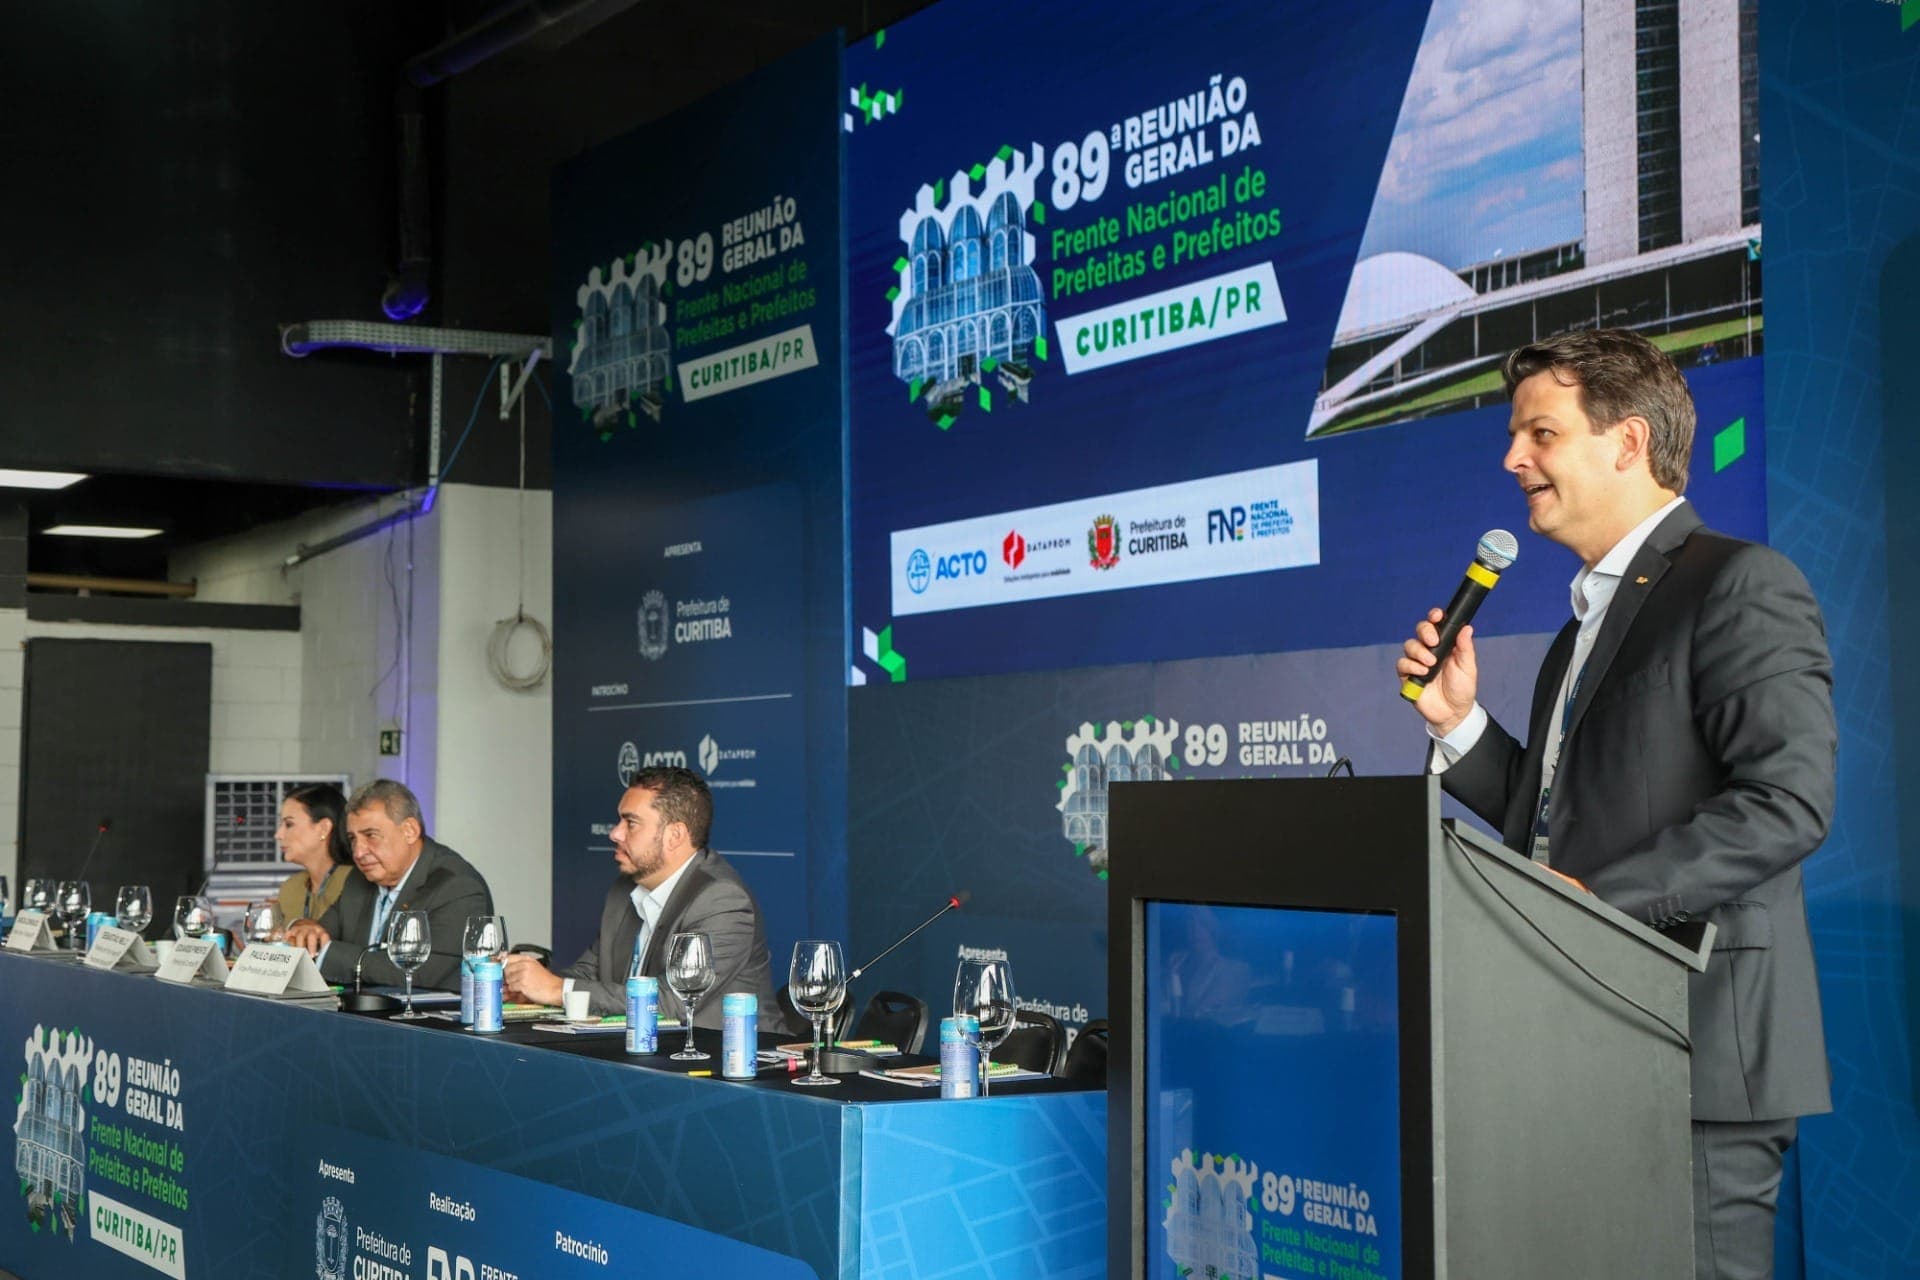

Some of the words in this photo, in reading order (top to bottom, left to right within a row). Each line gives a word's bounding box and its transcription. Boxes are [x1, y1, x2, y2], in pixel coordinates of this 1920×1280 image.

[1123, 74, 1248, 152] REUNIÃO
[1125, 131, 1214, 188] GERAL
[1221, 112, 1262, 157] DA
[1052, 216, 1120, 261] Frente
[1127, 174, 1227, 237] Nacional
[1234, 167, 1267, 199] de
[677, 232, 714, 287] 89
[723, 195, 797, 247] REUNIÃO
[722, 234, 777, 273] GERAL
[780, 221, 805, 253] DA
[1053, 249, 1146, 299] Prefeitas
[1152, 244, 1166, 270] e
[1173, 208, 1281, 265] Prefeitos
[677, 291, 719, 320] Frente
[723, 263, 785, 306] Nacional
[788, 261, 808, 283] de
[677, 314, 736, 349] Prefeitas
[738, 312, 748, 330] e
[751, 288, 817, 325] Prefeitos
[1075, 281, 1262, 357] CURITIBA/PR
[690, 337, 805, 391] CURITIBA/PR
[1129, 518, 1173, 534] Prefeitura
[1174, 514, 1187, 528] de
[1250, 498, 1278, 511] FRENTE
[1250, 508, 1289, 521] NACIONAL
[1129, 531, 1189, 556] CURITIBA
[1207, 505, 1246, 544] FNP
[664, 540, 703, 558] APRESENTA
[936, 549, 988, 581] ACTO
[676, 598, 718, 618] Prefeitura
[719, 594, 730, 614] de
[675, 617, 732, 644] CURITIBA
[1184, 723, 1228, 767] 89
[1238, 713, 1328, 743] REUNIÃO
[1239, 743, 1304, 767] GERAL
[1309, 742, 1337, 765] DA
[958, 944, 1008, 962] Apresenta
[1072, 1003, 1089, 1023] de
[93, 1049, 121, 1108] 89
[126, 1056, 181, 1097] REUNIÃO
[125, 1087, 164, 1124] GERAL
[166, 1099, 184, 1131] DA
[90, 1116, 121, 1149] Frente
[124, 1127, 167, 1166] Nacional
[170, 1143, 184, 1173] de
[88, 1147, 130, 1188] Prefeitas
[132, 1168, 140, 1188] e
[142, 1168, 188, 1210] Prefeitos
[318, 1159, 355, 1184] Apresenta
[429, 1191, 476, 1221] Realização
[1303, 1179, 1370, 1212] REUNIÃO
[96, 1205, 177, 1265] CURITIBA/PR
[1303, 1201, 1352, 1231] GERAL
[1355, 1212, 1378, 1237] DA
[356, 1226, 398, 1262] Prefeitura
[399, 1242, 411, 1266] de
[555, 1230, 609, 1265] Patrocínio
[1262, 1219, 1300, 1246] Frente
[1304, 1229, 1359, 1260] Nacional
[1363, 1243, 1380, 1265] de
[1262, 1242, 1315, 1274] Prefeitas
[1319, 1261, 1327, 1276] e
